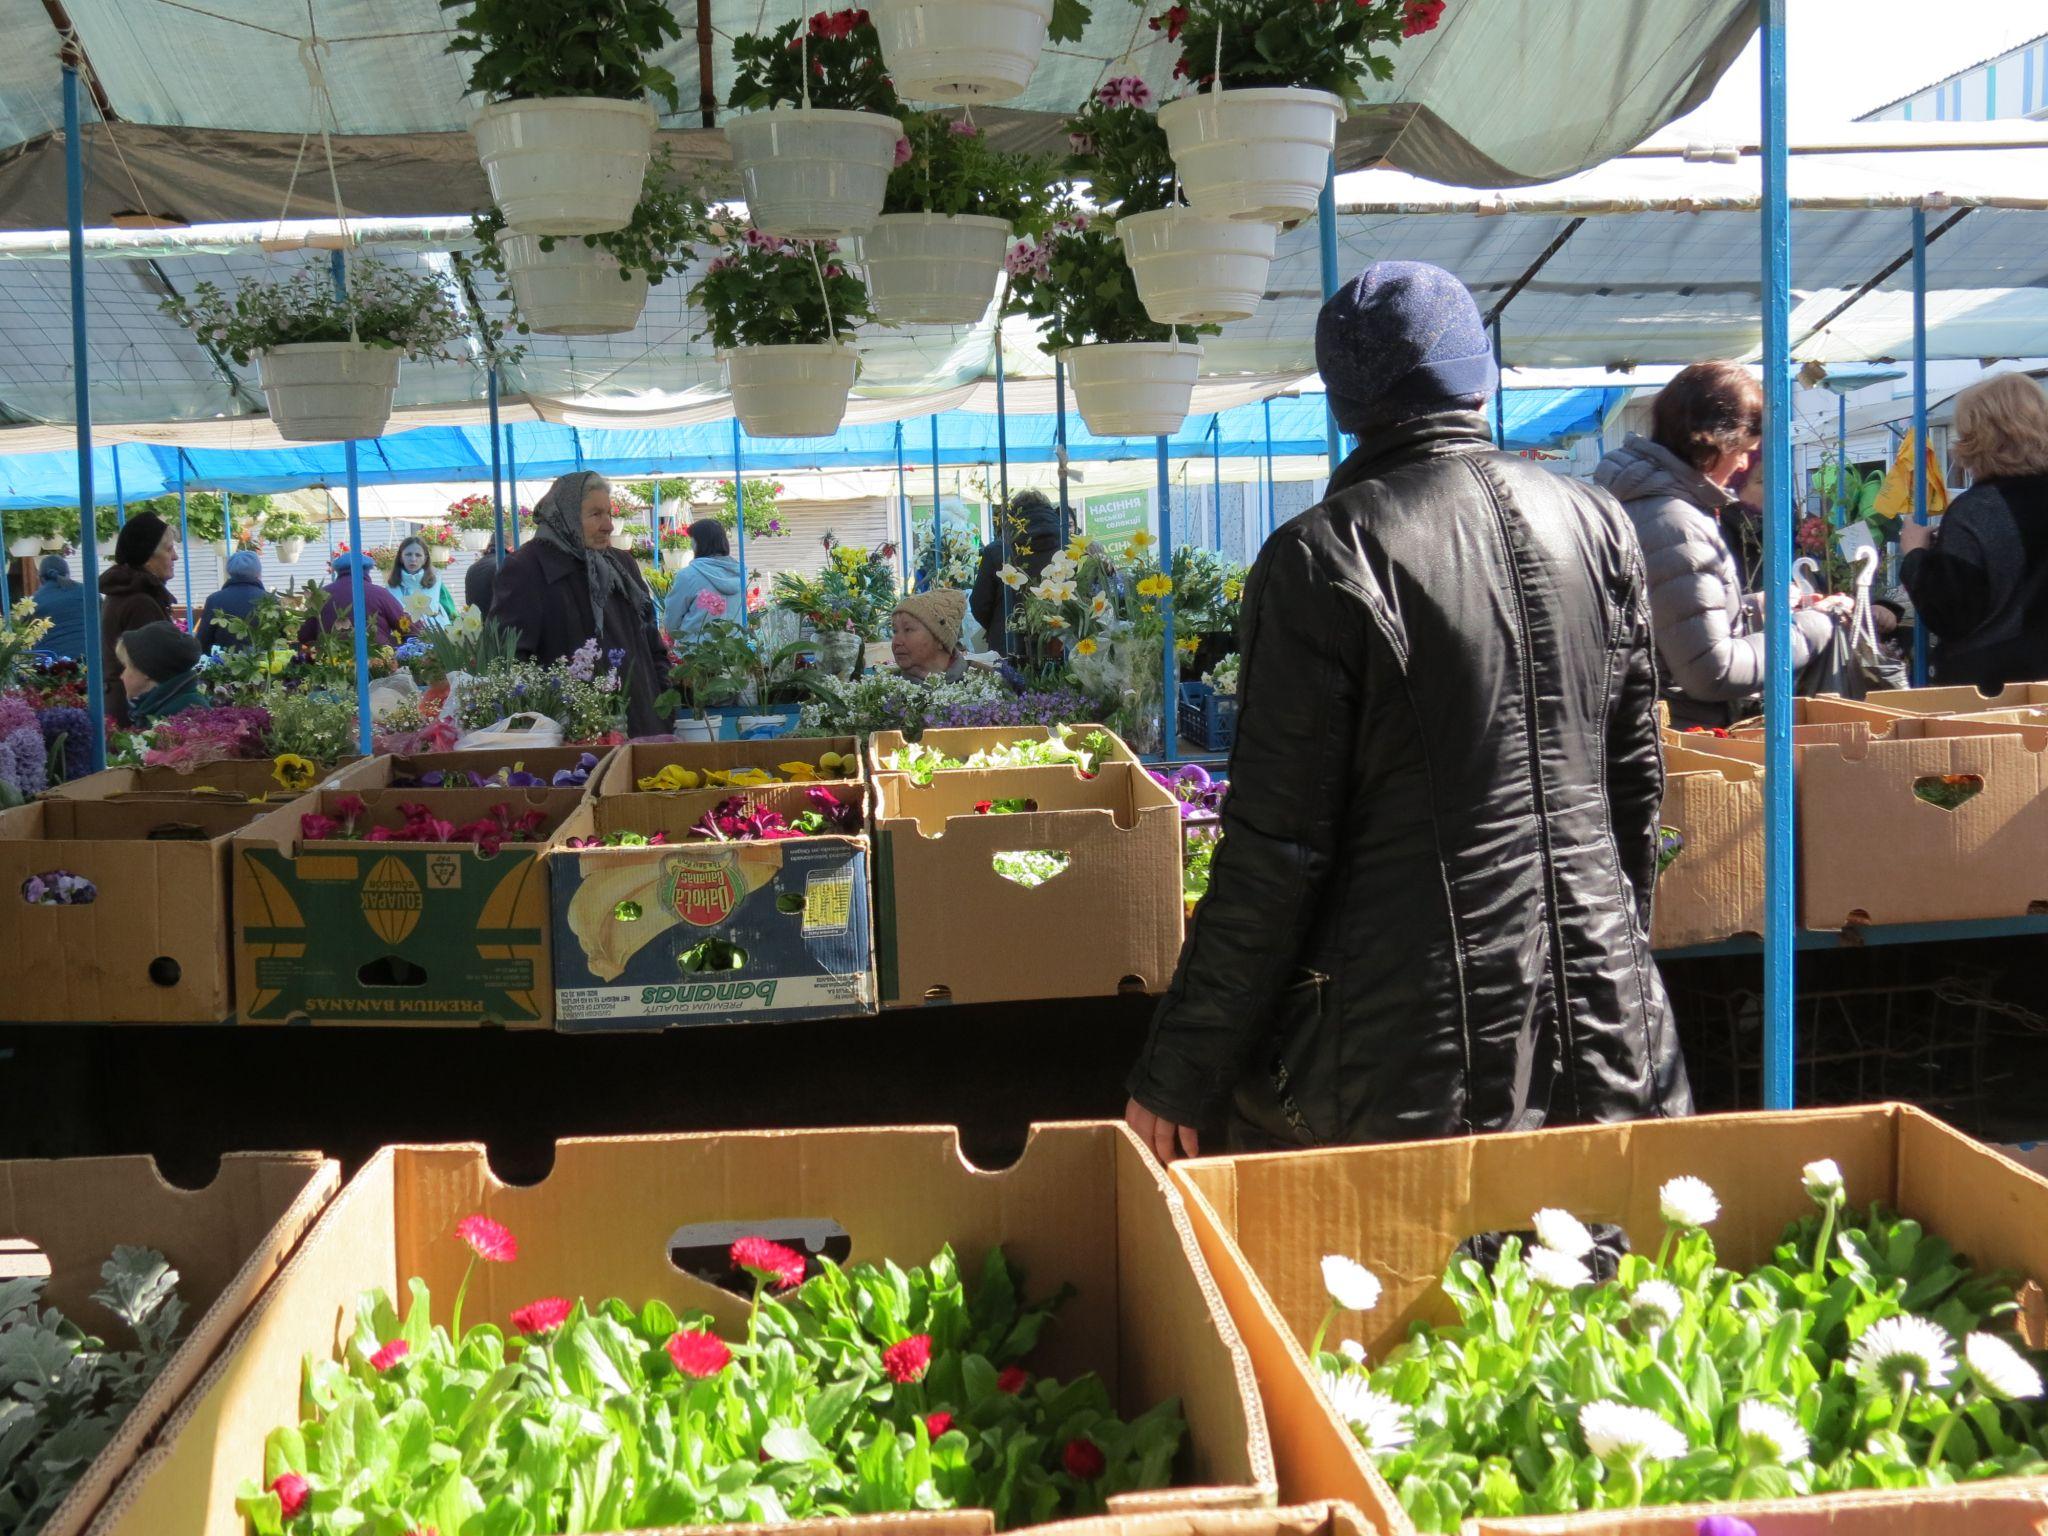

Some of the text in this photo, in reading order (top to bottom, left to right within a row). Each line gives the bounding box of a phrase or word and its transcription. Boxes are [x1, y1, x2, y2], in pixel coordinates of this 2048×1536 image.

[1089, 497, 1141, 515] НАСІННЯ
[1106, 515, 1141, 528] селекції
[369, 880, 414, 889] ECUADOR
[680, 871, 724, 886] Bananas
[360, 892, 423, 910] EQUAPAK
[674, 886, 730, 914] Dakota
[641, 980, 777, 1006] bananas
[305, 998, 485, 1012] PREMIUM BANANAS
[642, 1001, 743, 1014] PREMIUM QUALITY
